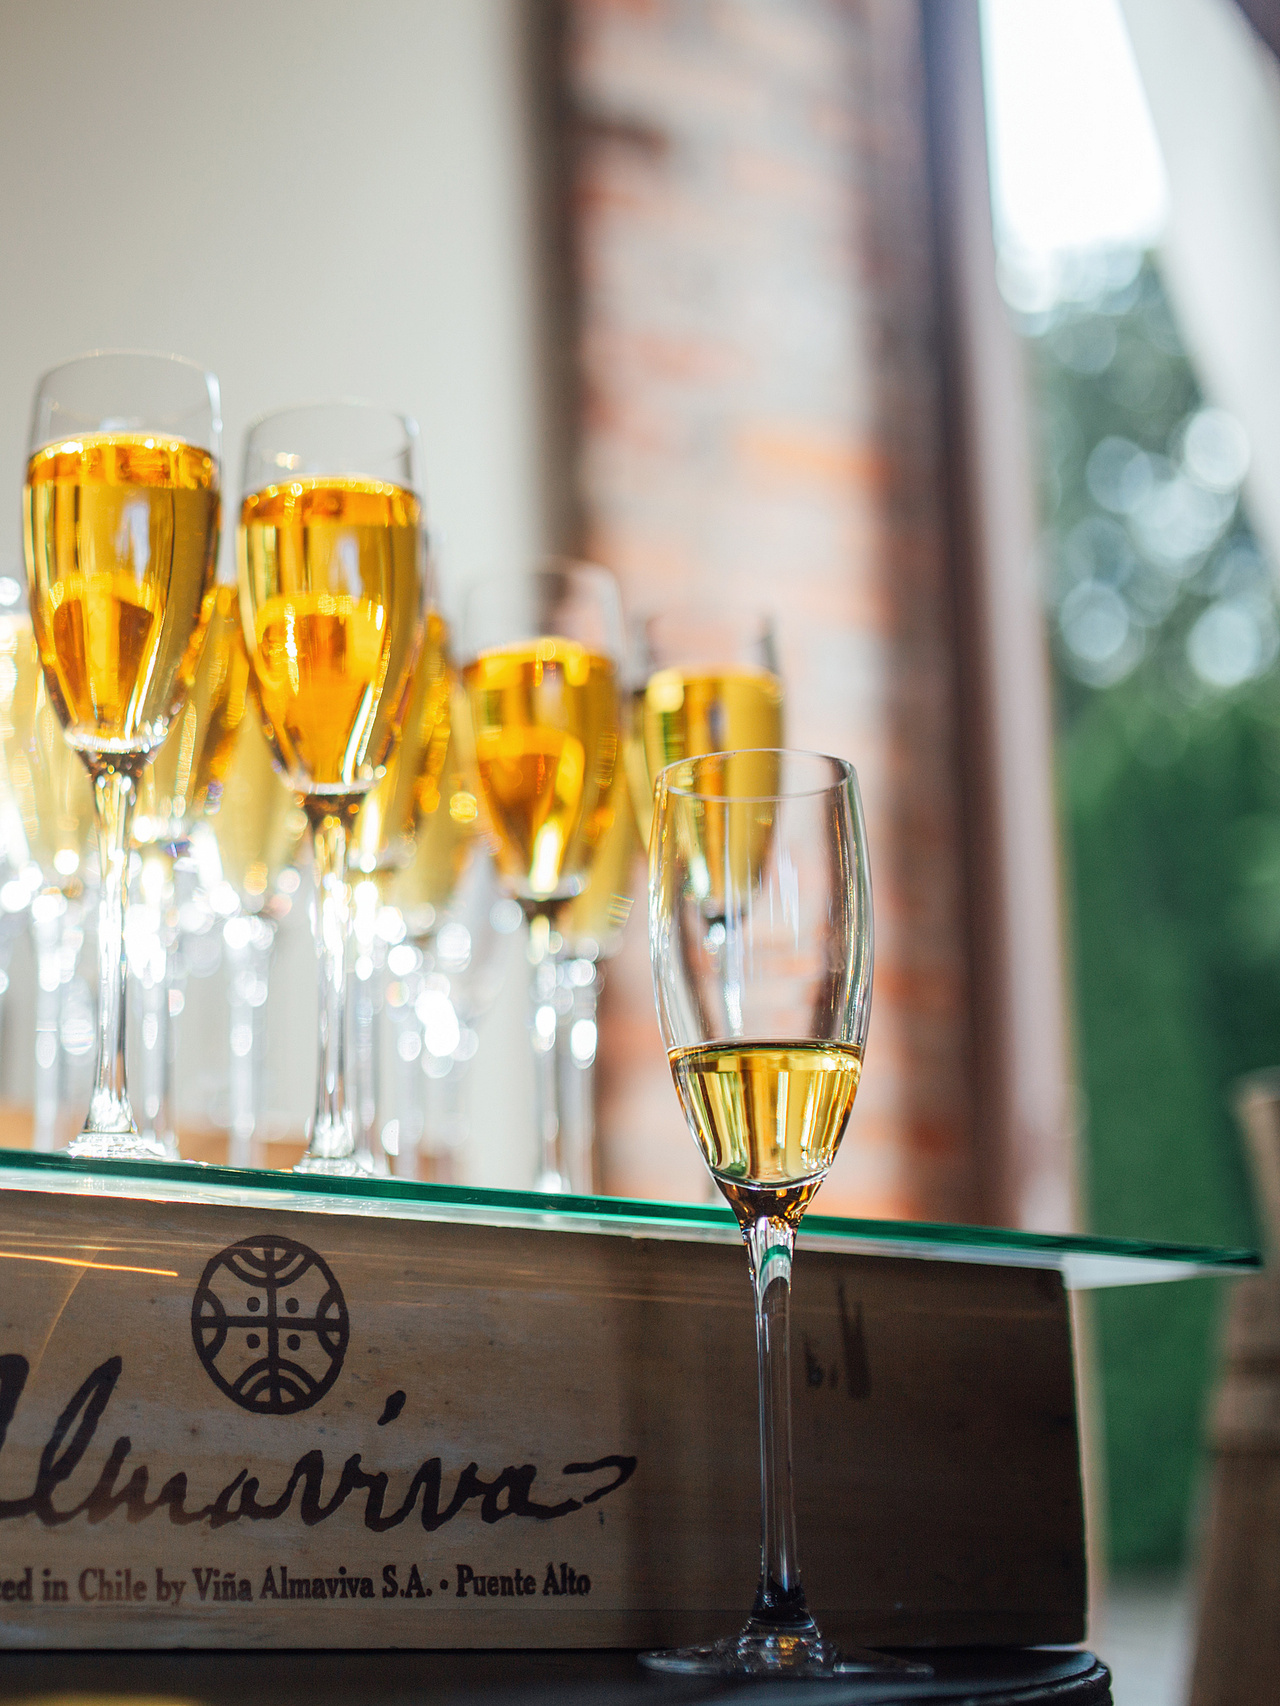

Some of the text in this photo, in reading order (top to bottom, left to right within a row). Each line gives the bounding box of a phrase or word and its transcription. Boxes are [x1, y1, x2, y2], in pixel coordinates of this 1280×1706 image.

[42, 1567, 69, 1602] in
[78, 1567, 148, 1602] Chile
[155, 1567, 187, 1607] by
[192, 1567, 254, 1602] Viña
[259, 1565, 376, 1600] Almaviva
[382, 1563, 433, 1599] S.A.
[455, 1563, 538, 1598] Puente
[542, 1561, 592, 1597] Alto
